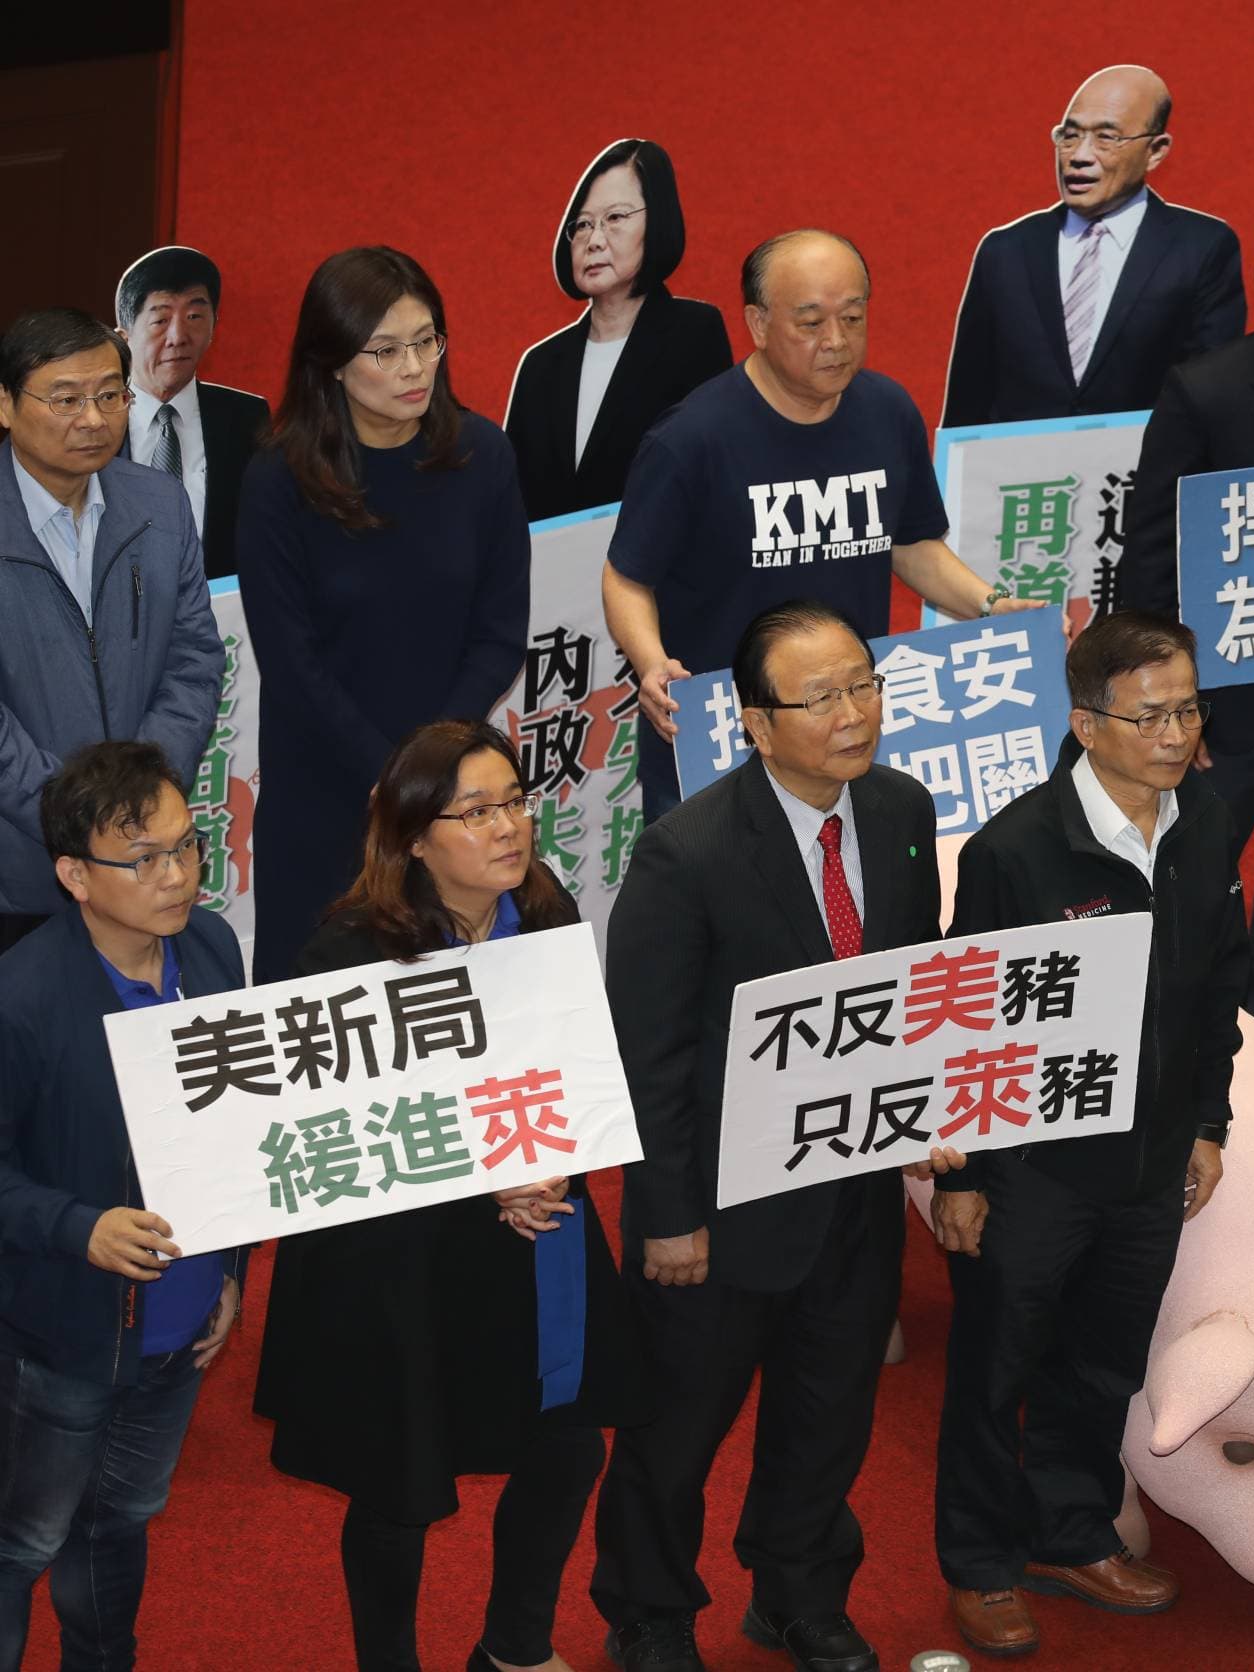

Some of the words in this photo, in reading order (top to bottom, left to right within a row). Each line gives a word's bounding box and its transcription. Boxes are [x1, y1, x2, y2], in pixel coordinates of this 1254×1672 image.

[748, 469, 887, 551] KMT
[752, 550, 792, 568] LEAN
[799, 546, 814, 564] IN
[822, 535, 892, 560] TOGETHER
[171, 966, 488, 1113] 美新局
[749, 946, 1081, 1071] 不反美豬
[258, 1068, 577, 1214] 緩進萊
[784, 1042, 1118, 1172] 只反萊豬
